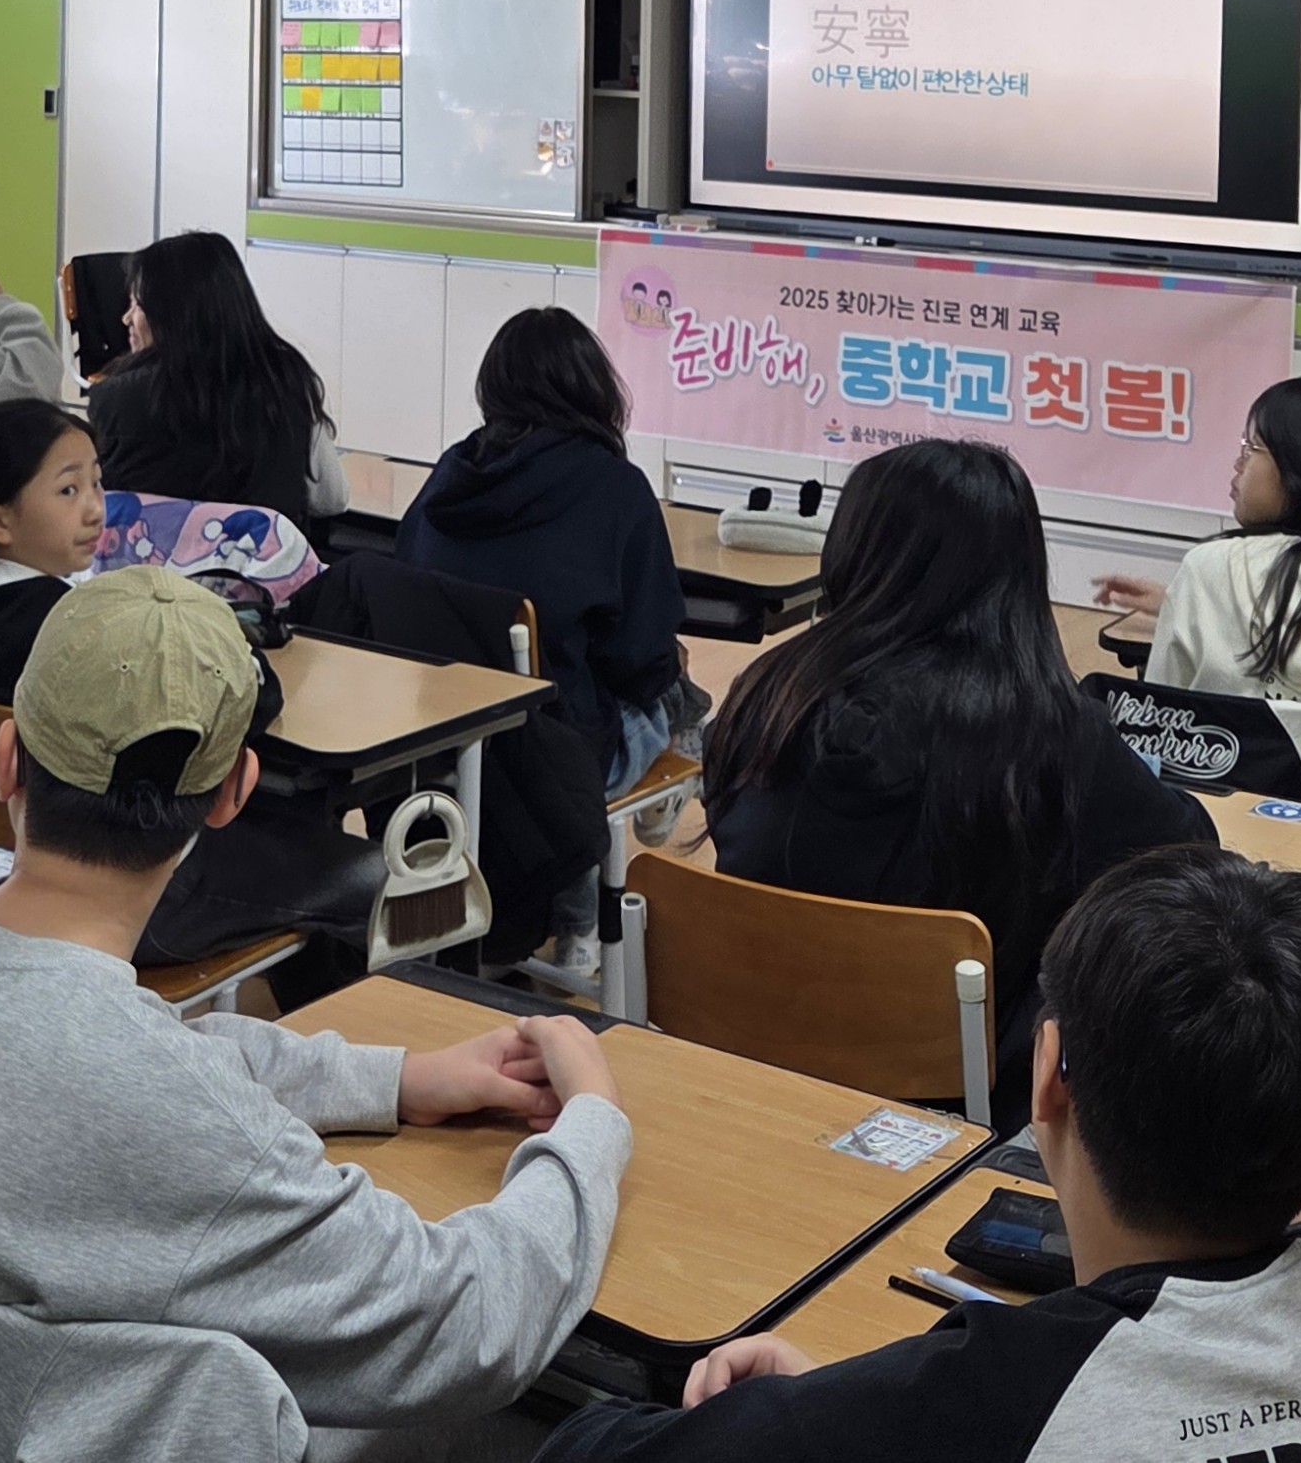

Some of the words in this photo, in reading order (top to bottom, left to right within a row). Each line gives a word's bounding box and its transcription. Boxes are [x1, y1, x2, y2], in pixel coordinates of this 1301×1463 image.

[812, 3, 910, 59] 安寧
[811, 63, 854, 88] 아무
[857, 65, 918, 92] 탈없이
[779, 286, 829, 310] 2025
[836, 290, 915, 321] 찾아가는
[922, 298, 962, 326] 진로
[970, 303, 1010, 331] 연계
[1018, 308, 1061, 336] 교육
[670, 310, 823, 400] 준비해,
[840, 335, 1013, 417] 중학교
[1026, 356, 1087, 426] 첫
[1104, 365, 1188, 436] 봄!
[1179, 1412, 1232, 1441] JUST
[1239, 1409, 1256, 1429] A
